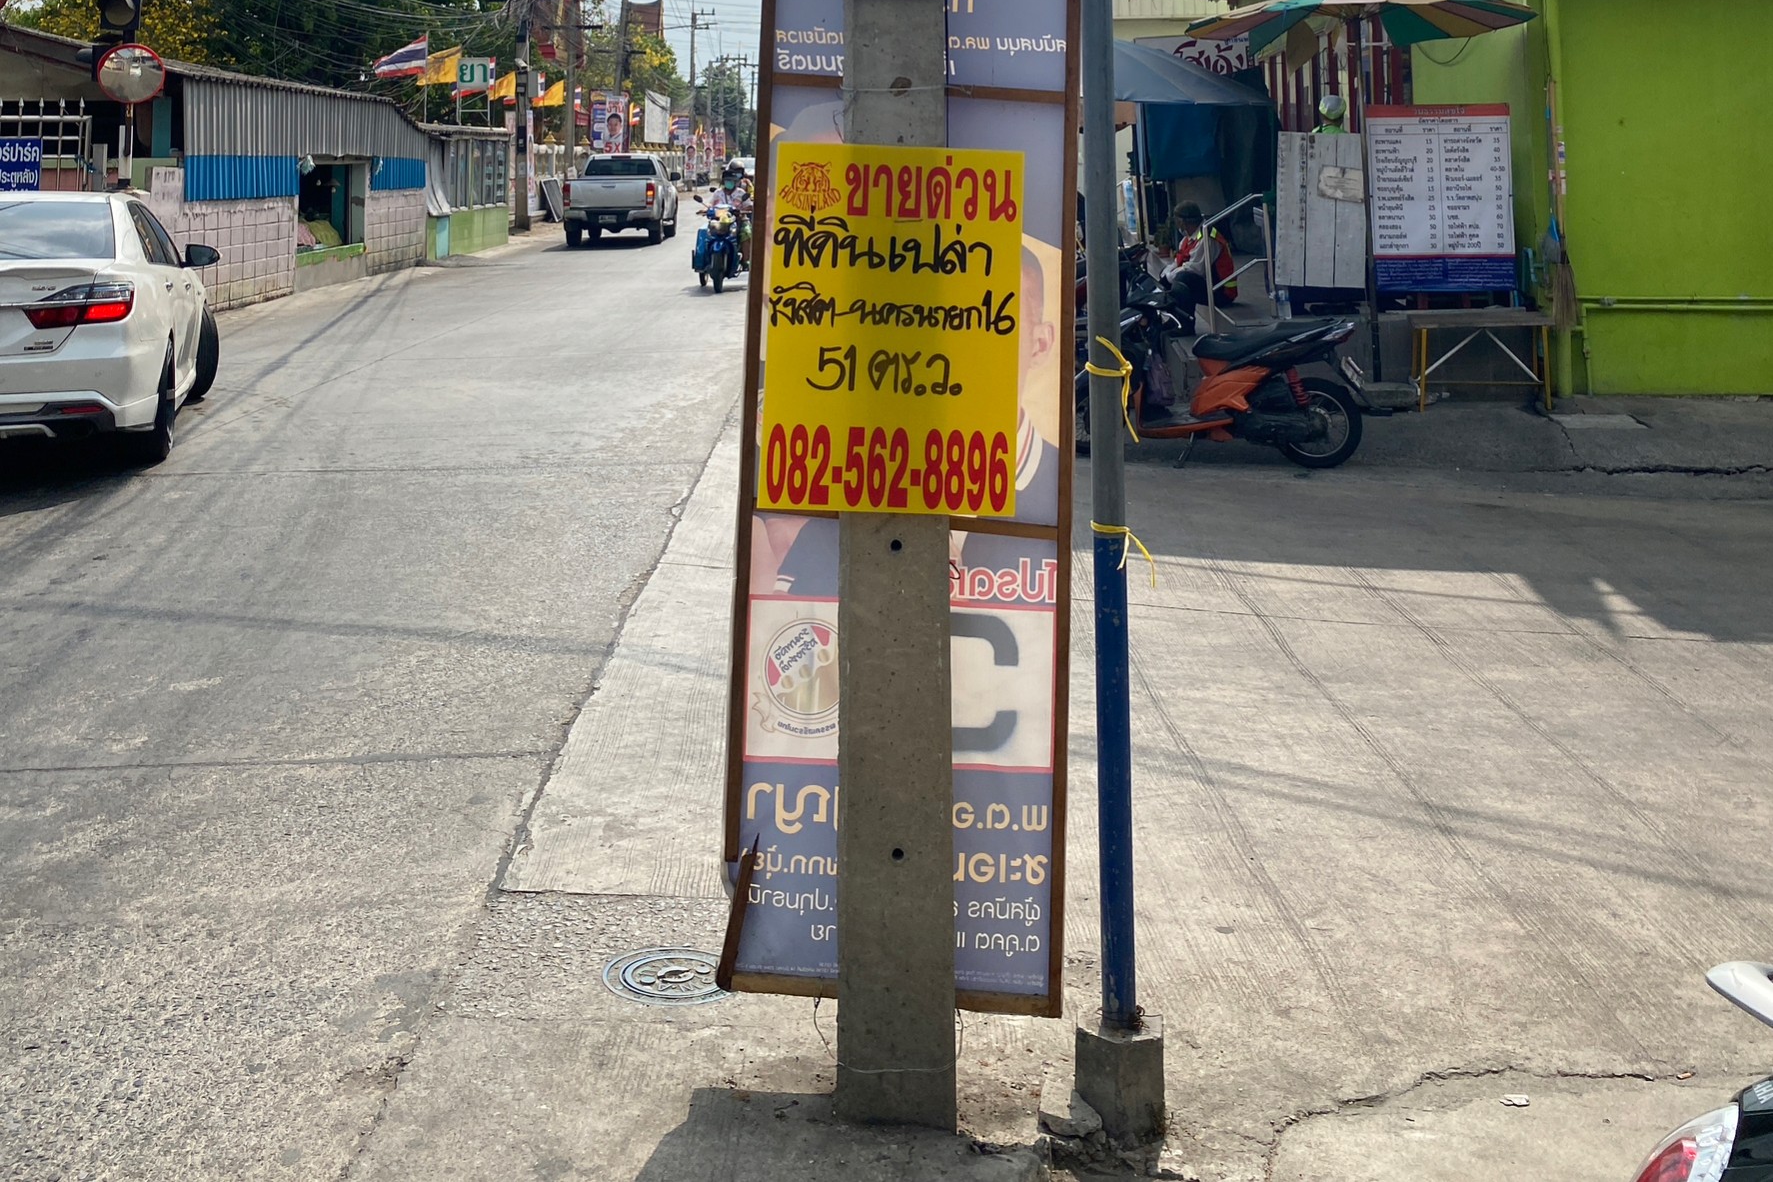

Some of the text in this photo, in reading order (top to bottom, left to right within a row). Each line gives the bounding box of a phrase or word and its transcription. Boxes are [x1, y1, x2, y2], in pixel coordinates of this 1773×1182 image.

[458, 62, 488, 84] ยา
[845, 156, 1017, 222] ขายด่วน
[773, 204, 993, 276] ที่ดินเปล่า
[806, 344, 857, 391] 51
[766, 423, 1010, 513] 082-562-8896
